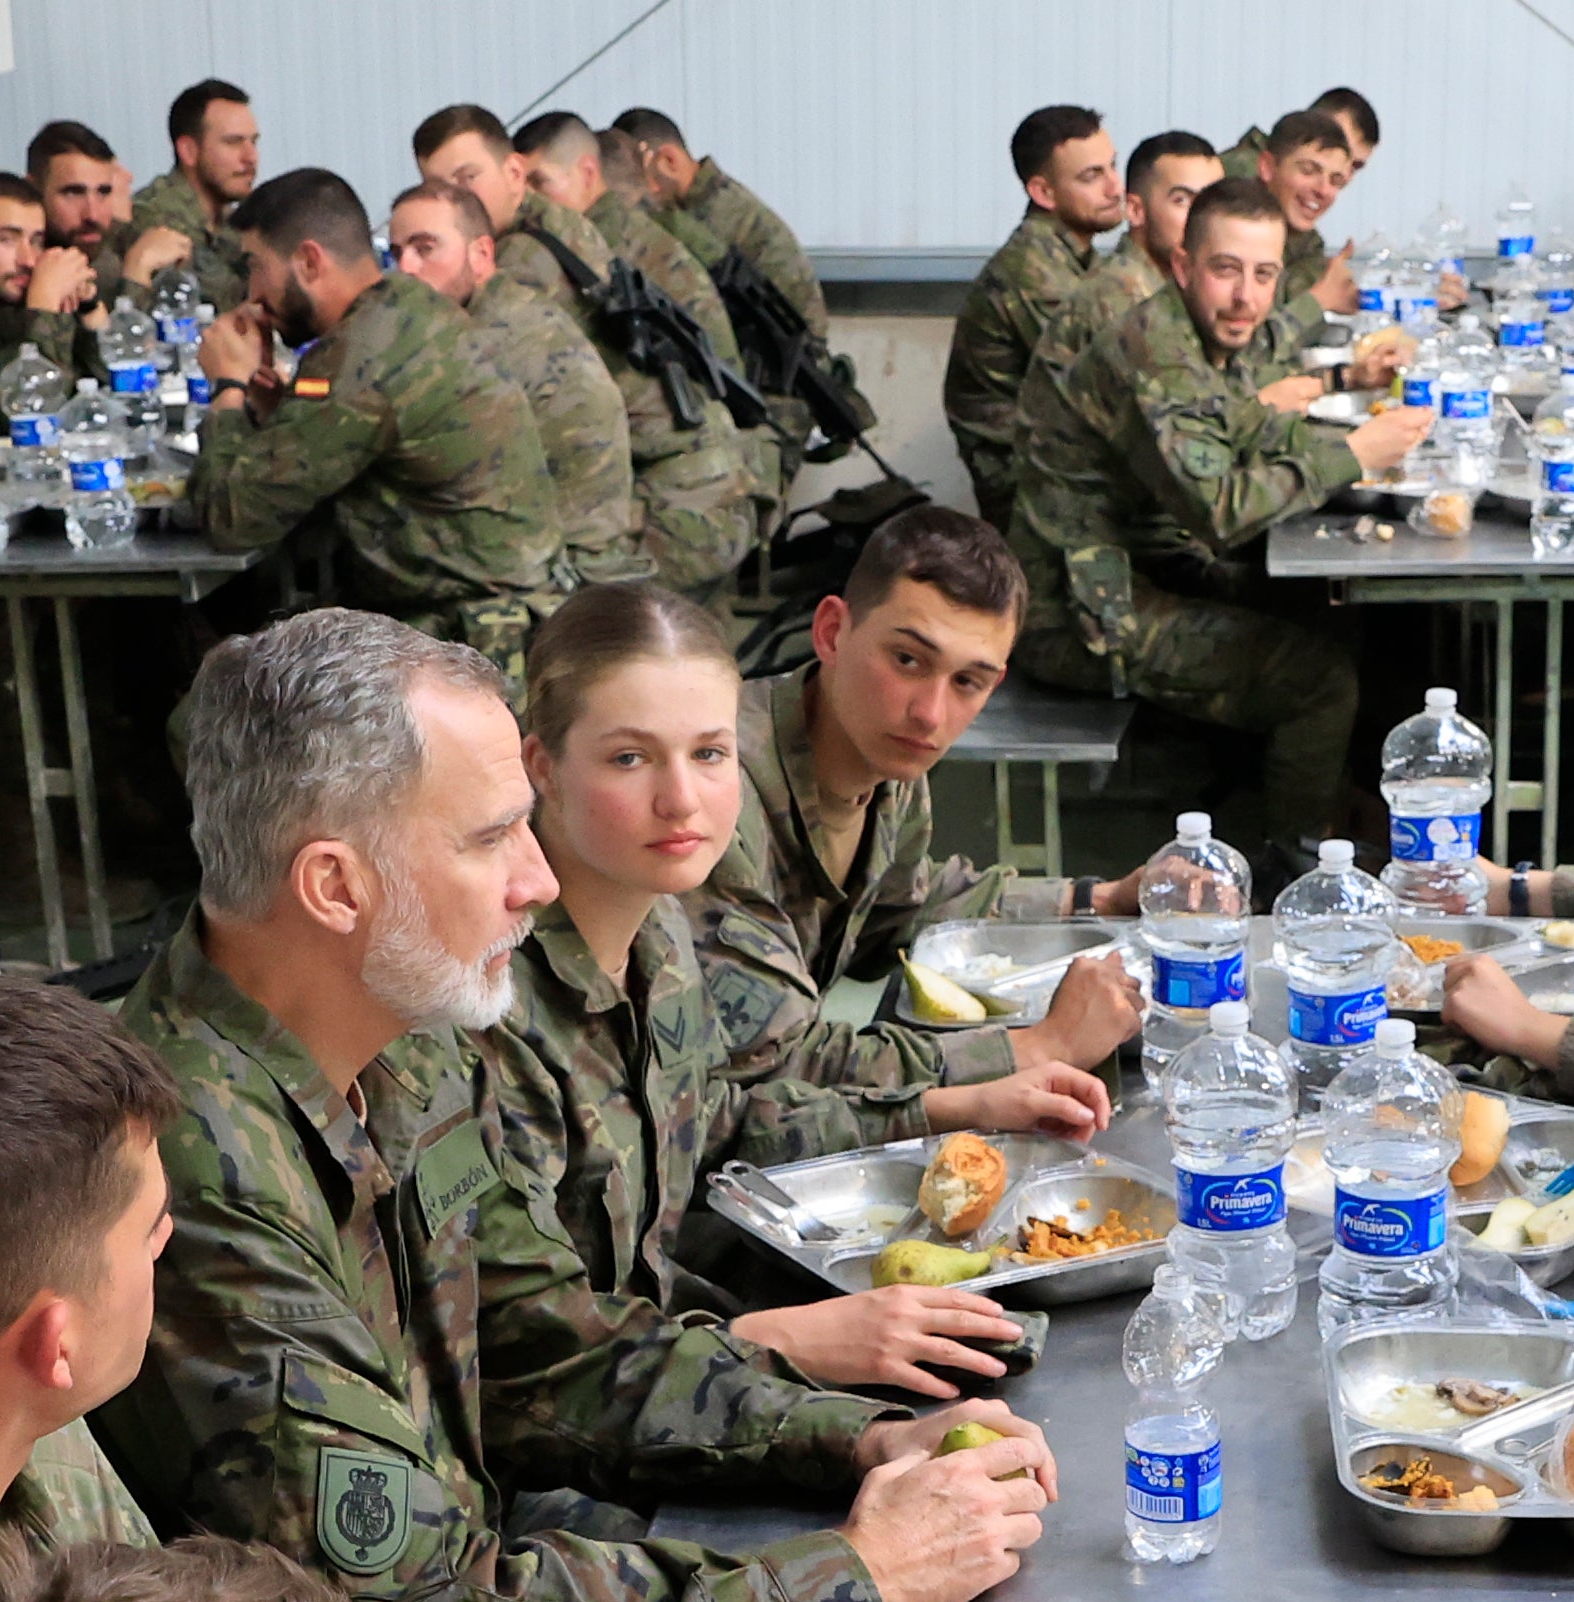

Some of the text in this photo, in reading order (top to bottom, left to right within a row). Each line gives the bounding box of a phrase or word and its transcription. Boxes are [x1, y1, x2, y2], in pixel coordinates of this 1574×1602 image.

[438, 1163, 489, 1211] BORBÓN
[1210, 1192, 1273, 1210] Primavera
[1343, 1213, 1404, 1236] Primavera
